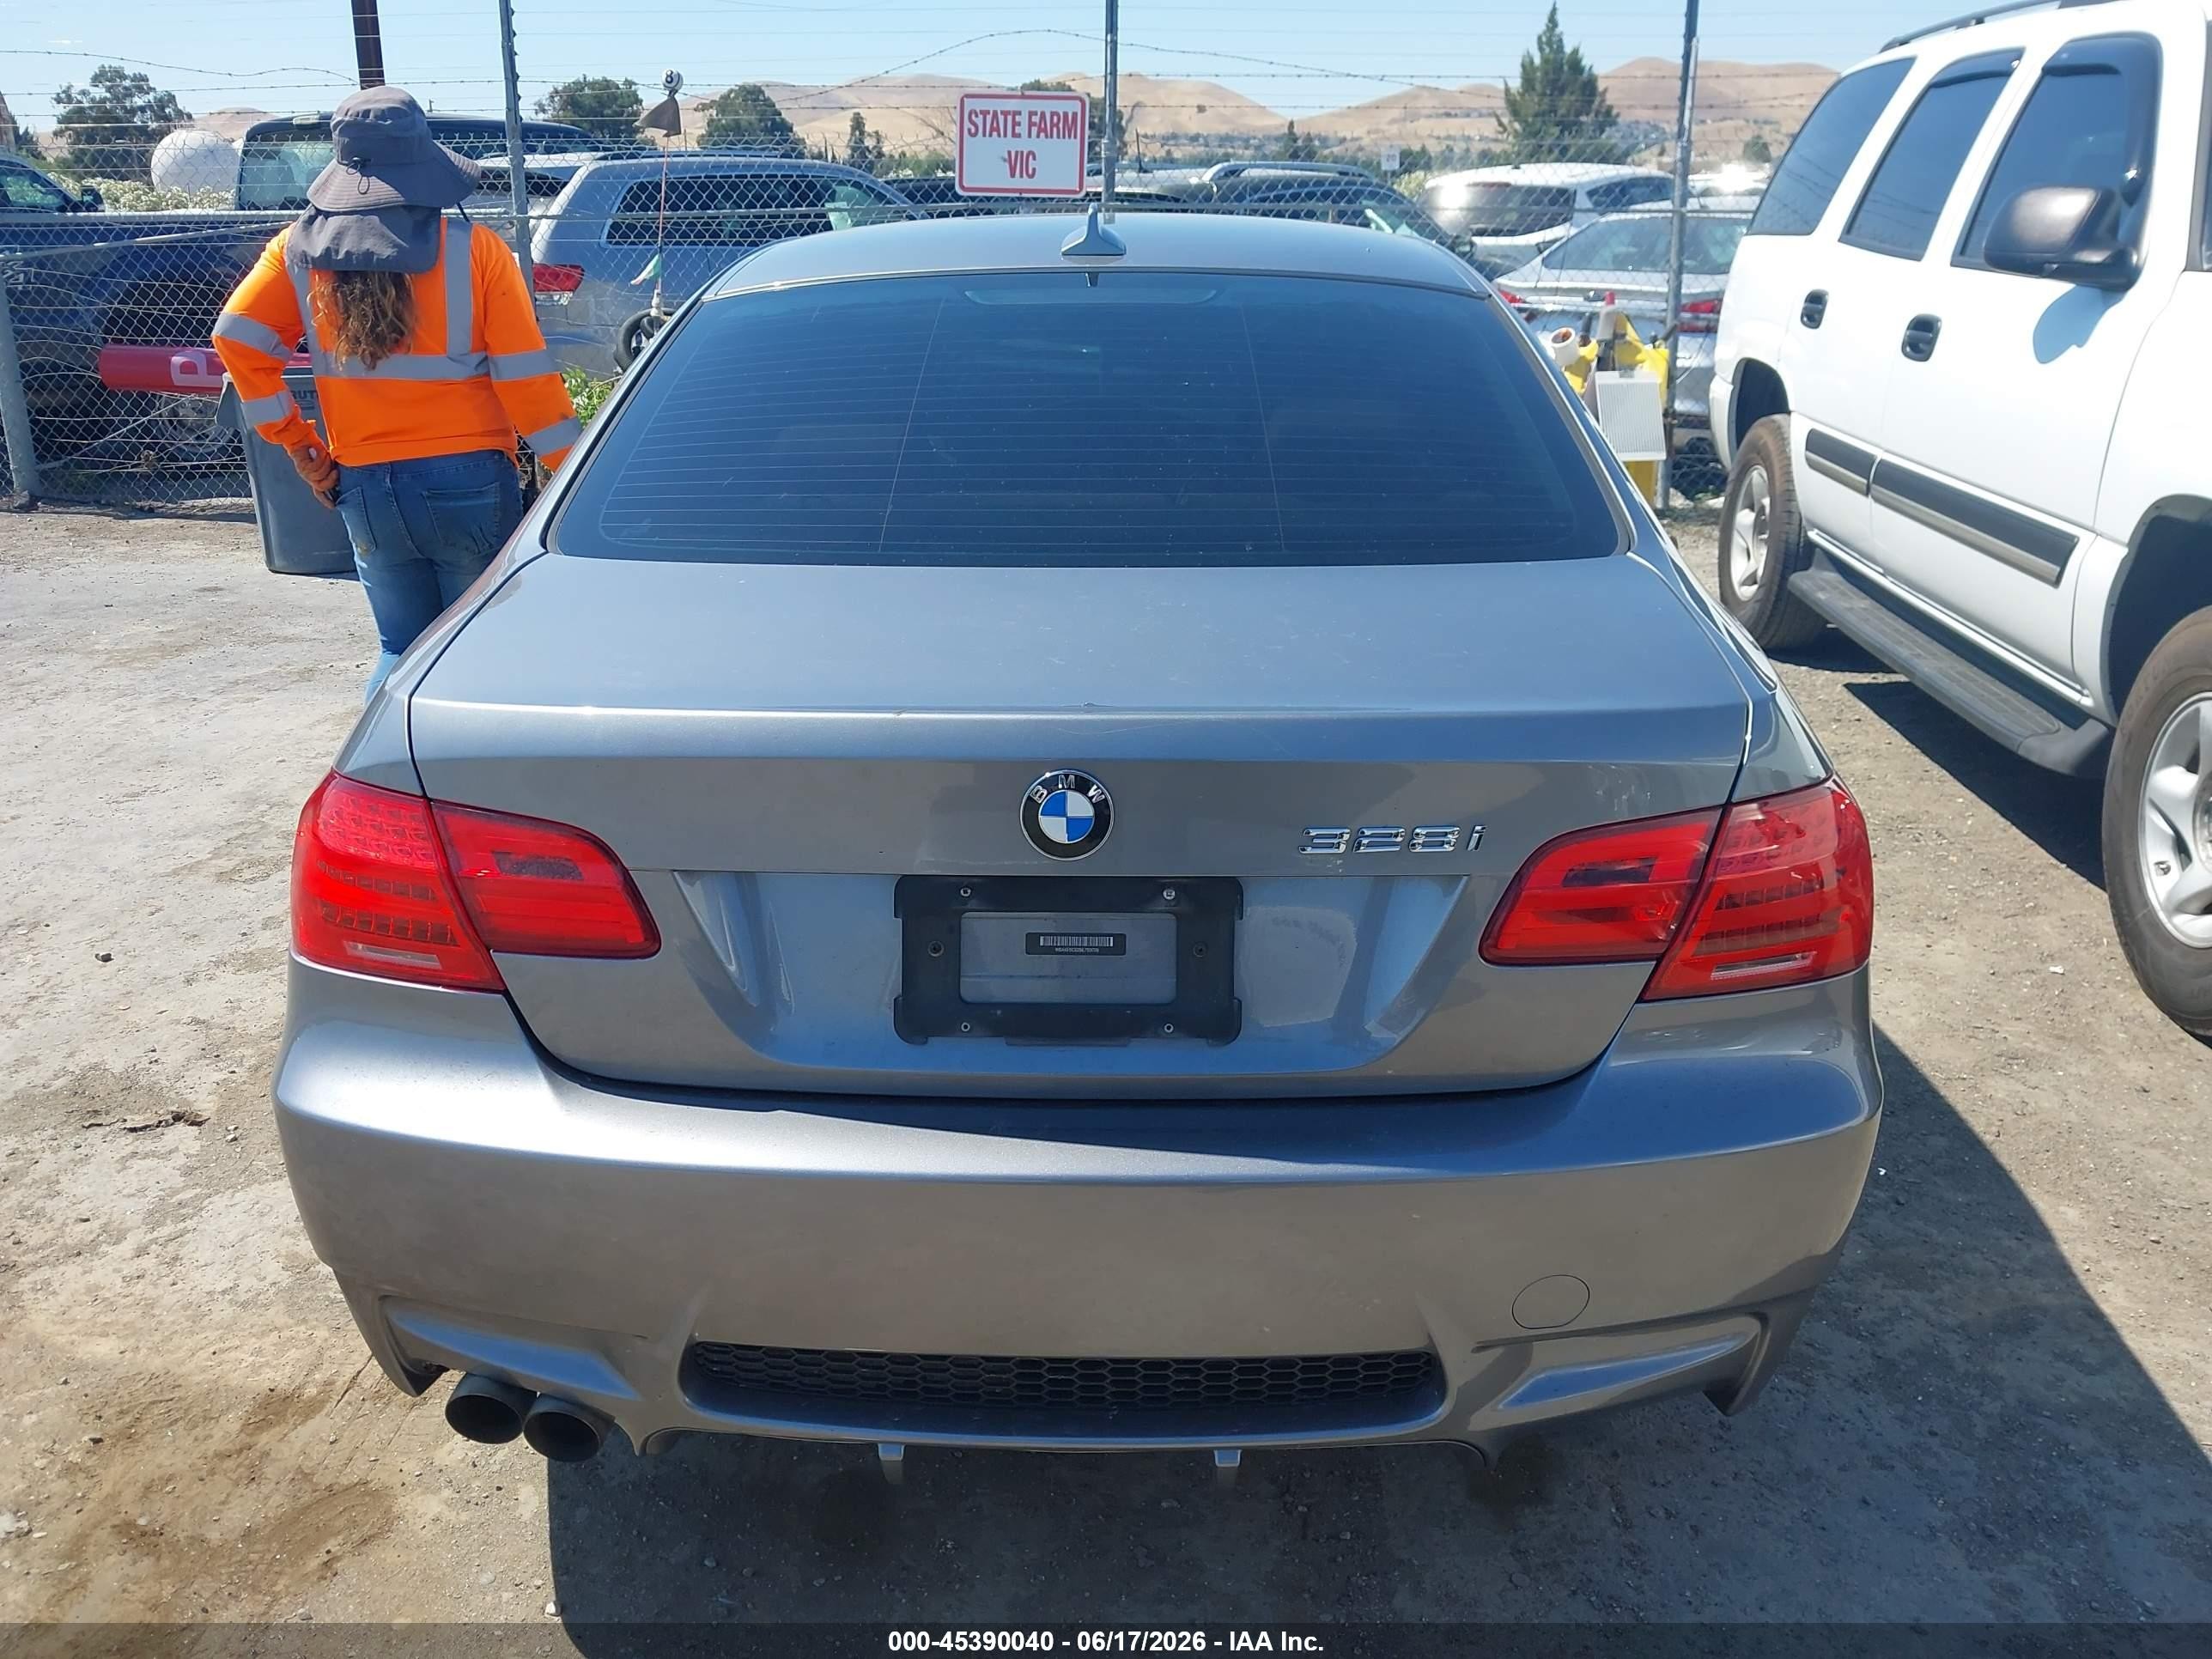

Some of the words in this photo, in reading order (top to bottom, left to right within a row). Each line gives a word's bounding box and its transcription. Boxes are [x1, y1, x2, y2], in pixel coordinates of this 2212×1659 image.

[665, 69, 674, 84] 8
[967, 108, 1022, 138] STATE
[1027, 110, 1079, 140] FARM
[1006, 150, 1037, 179] VIC
[1030, 774, 1106, 804] BMW
[1298, 824, 1489, 854] 328i
